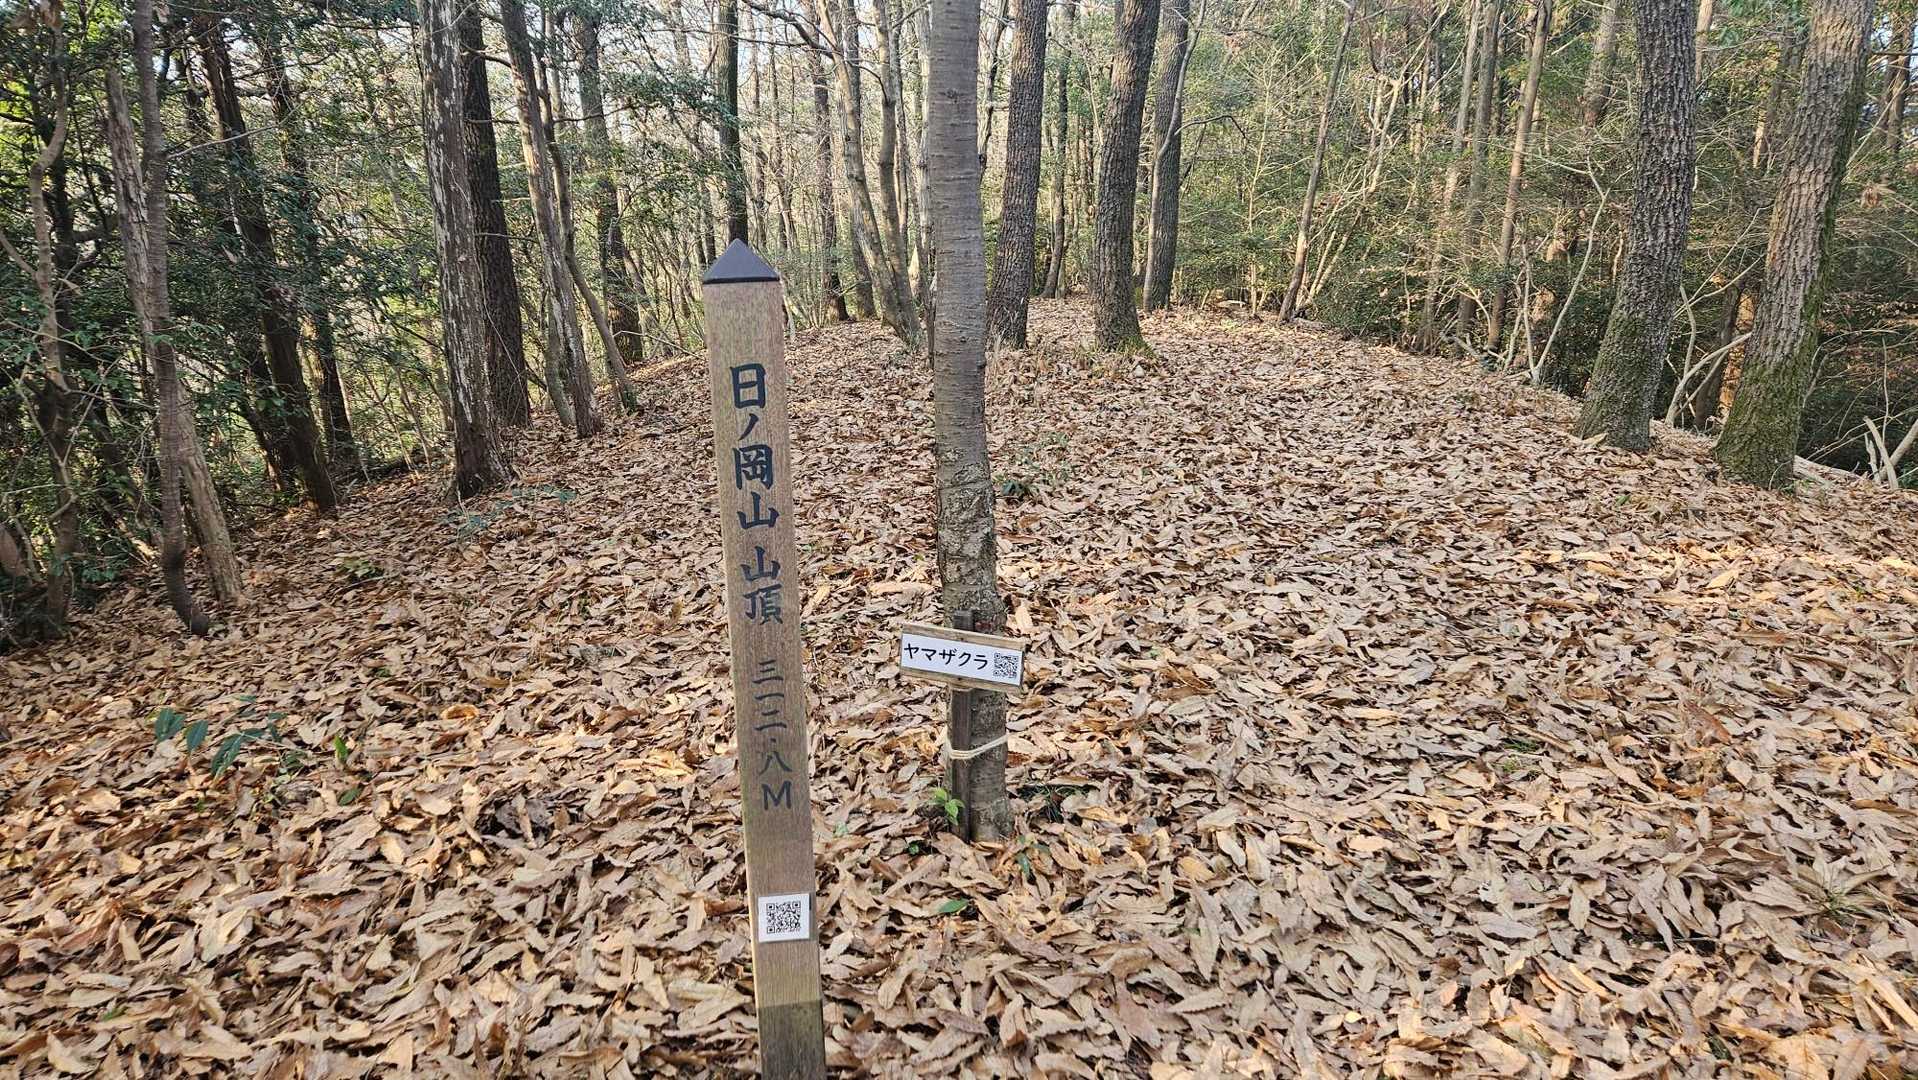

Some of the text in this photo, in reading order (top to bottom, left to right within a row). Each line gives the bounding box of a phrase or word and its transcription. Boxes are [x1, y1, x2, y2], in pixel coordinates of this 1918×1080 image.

[903, 643, 989, 671] ヤマザクラ
